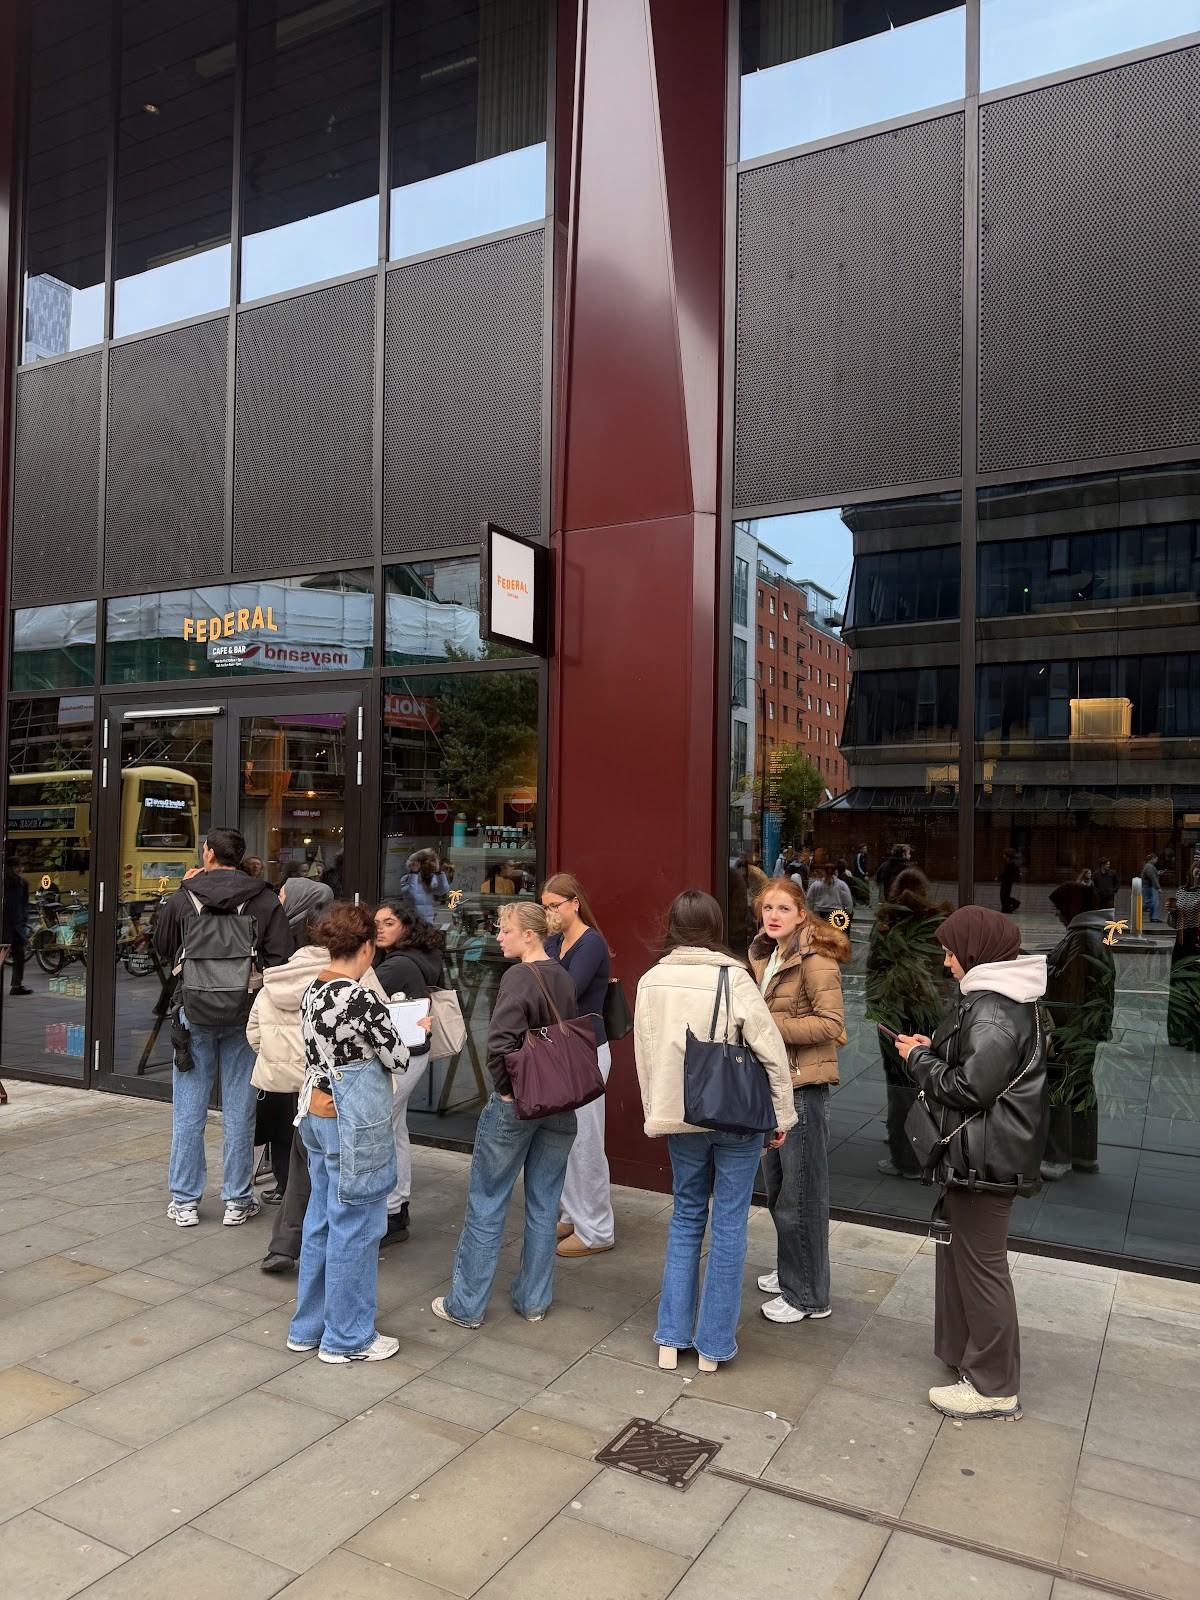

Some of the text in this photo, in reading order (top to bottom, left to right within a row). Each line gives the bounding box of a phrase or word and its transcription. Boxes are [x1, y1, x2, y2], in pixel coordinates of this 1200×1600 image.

[496, 574, 529, 595] FEDERAL
[183, 605, 278, 643] FEDERAL
[212, 645, 247, 656] CAFE & BAR
